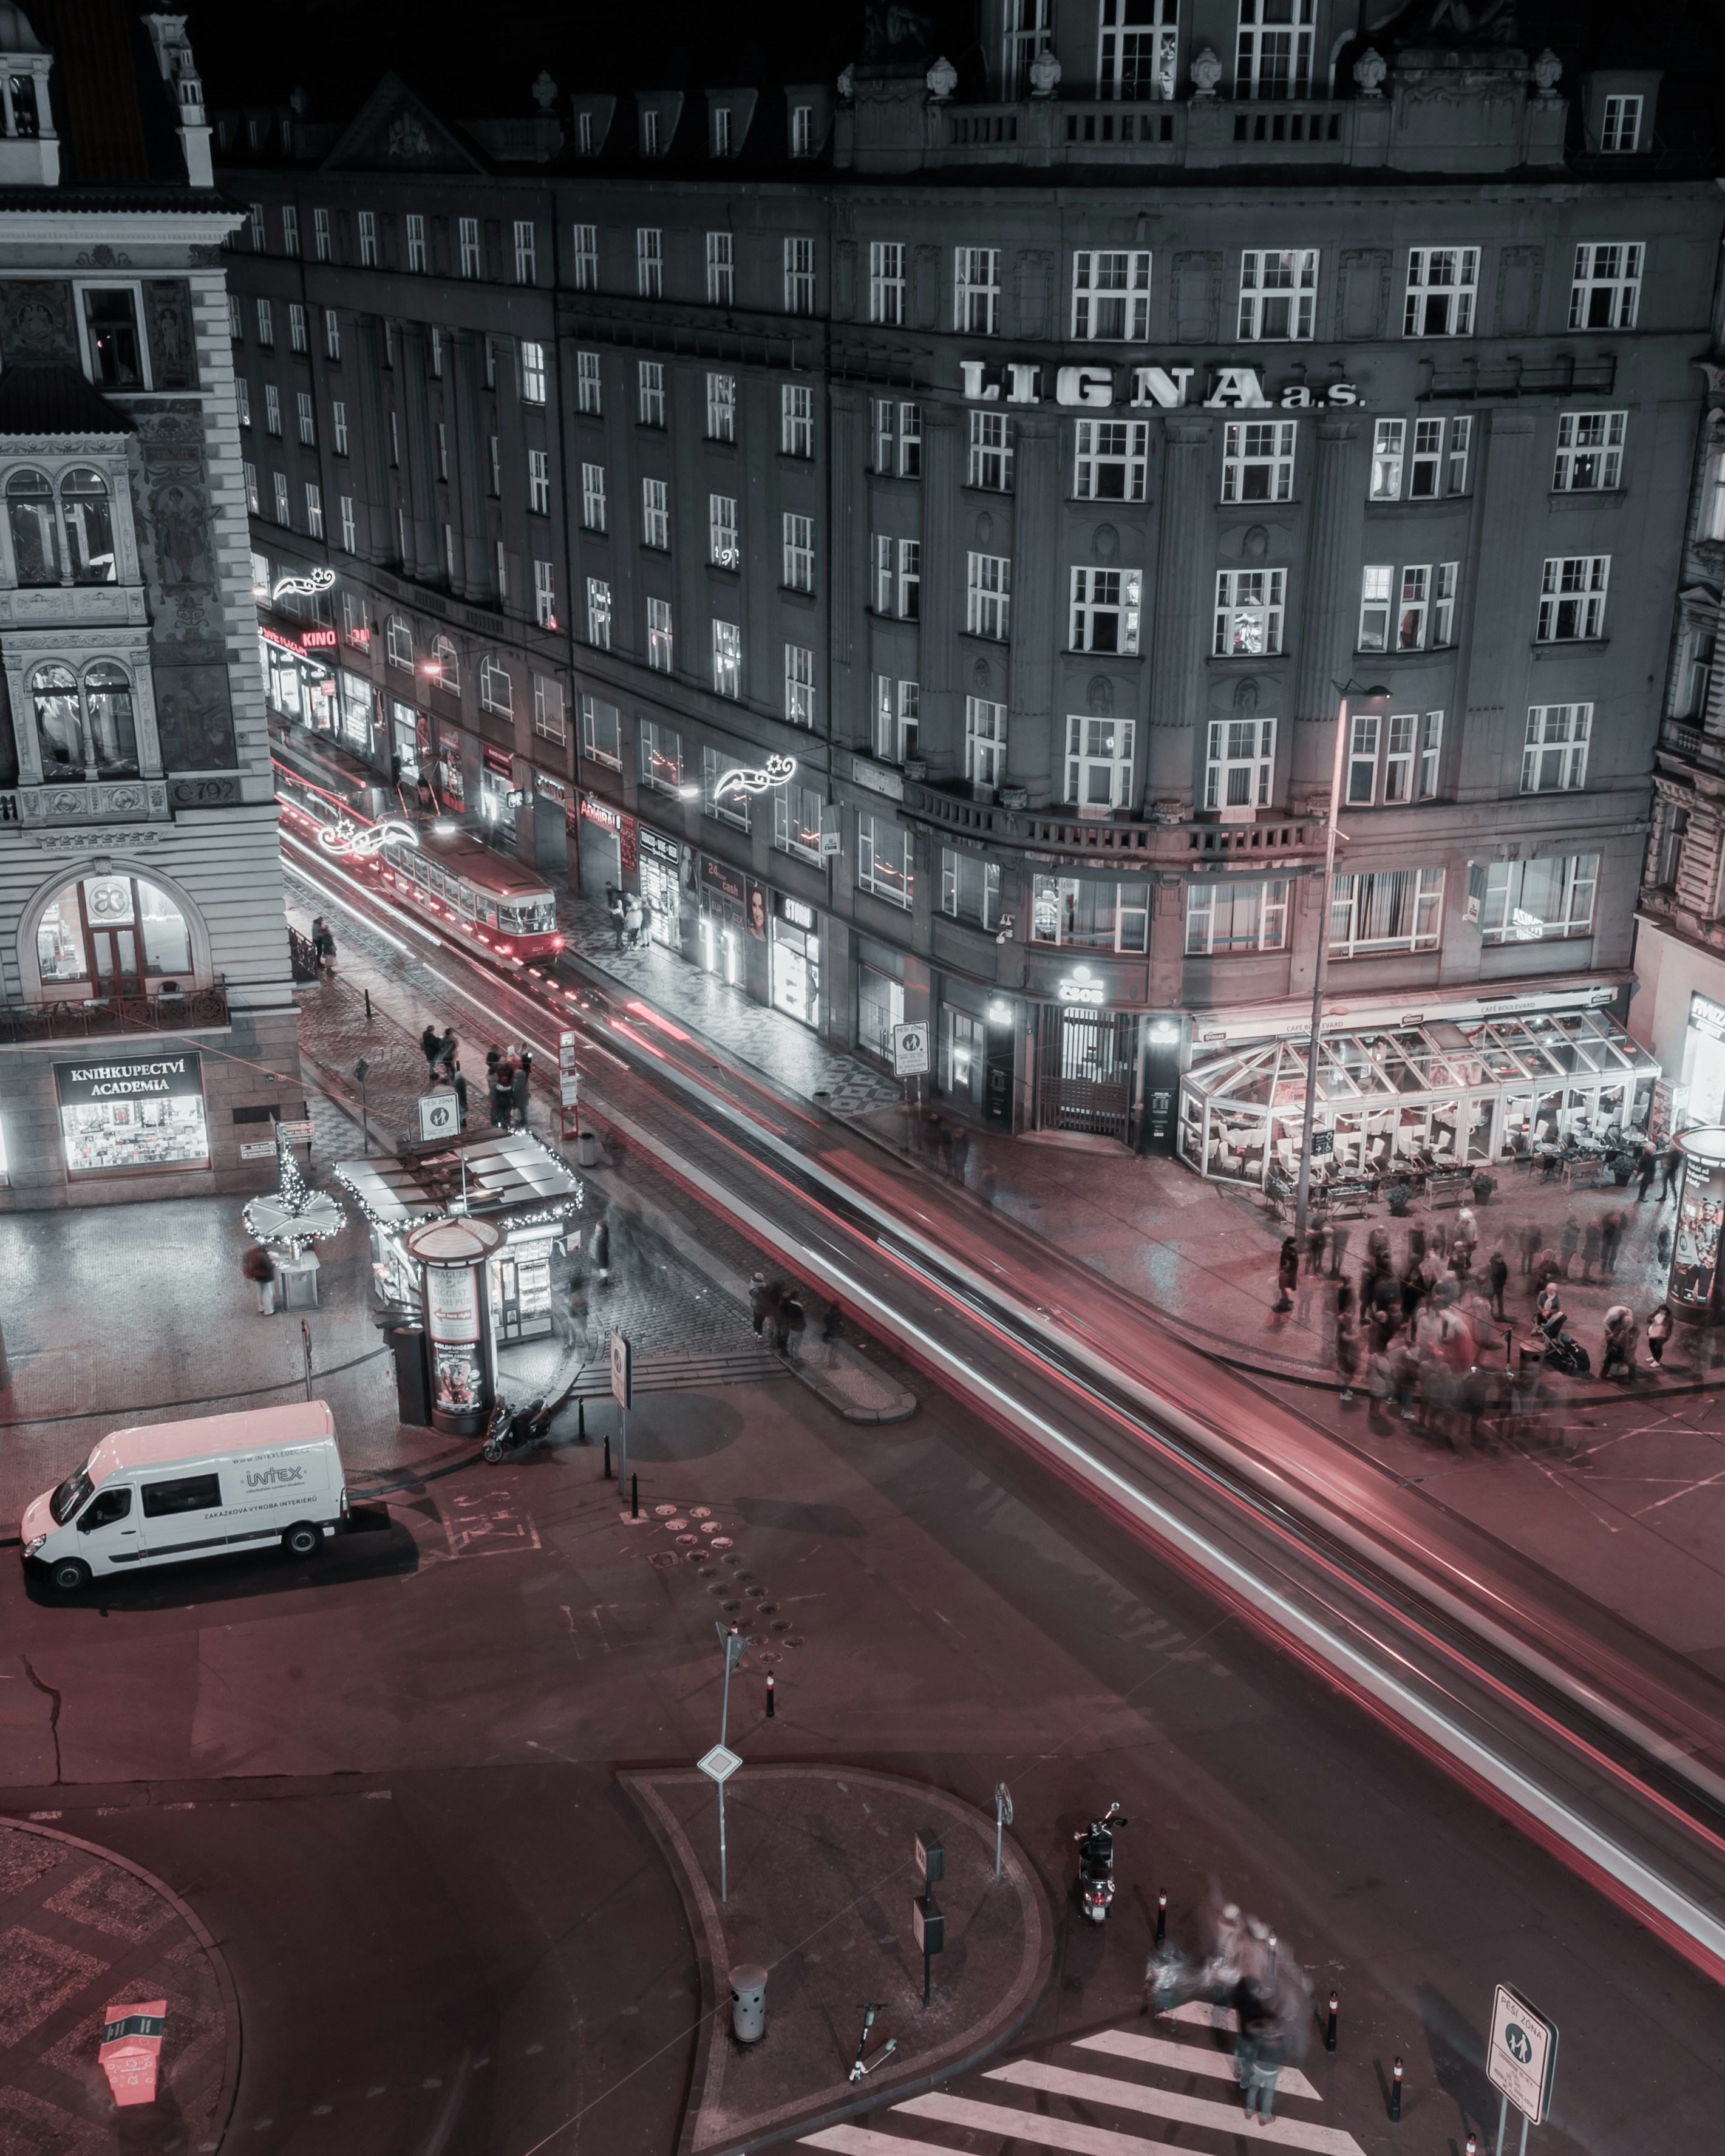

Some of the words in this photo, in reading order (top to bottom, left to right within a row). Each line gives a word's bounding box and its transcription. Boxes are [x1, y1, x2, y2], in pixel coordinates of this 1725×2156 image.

[960, 361, 1274, 409] LIGNA
[1281, 383, 1367, 409] a.s.
[303, 631, 335, 646] KINO
[197, 782, 234, 800] 792
[709, 862, 718, 876] 24
[723, 881, 738, 896] cash
[732, 913, 744, 925] CZK
[1498, 1002, 1536, 1012] BOULEVARD
[1304, 1021, 1344, 1030] BOEVARD
[71, 1059, 185, 1081] KNIHKUPECTVÍ
[91, 1079, 170, 1096] ACADEMIA
[430, 1269, 468, 1279] PRAGUES
[434, 1288, 468, 1297] BIGGEST
[432, 1296, 452, 1306] IRISH
[455, 1297, 472, 1306] PUB
[434, 1342, 475, 1350] GOLDFINGERS
[233, 1447, 310, 1464] WWW.INTEXLEDEC.CZ
[204, 1508, 248, 1520] ZAKÁZKOVÁ
[248, 1503, 279, 1512] VÝROBA
[280, 1495, 317, 1507] INTERIÉRŮ
[1501, 1996, 1518, 2018] PĚŠÍ
[1520, 2015, 1542, 2041] ZÓNA
